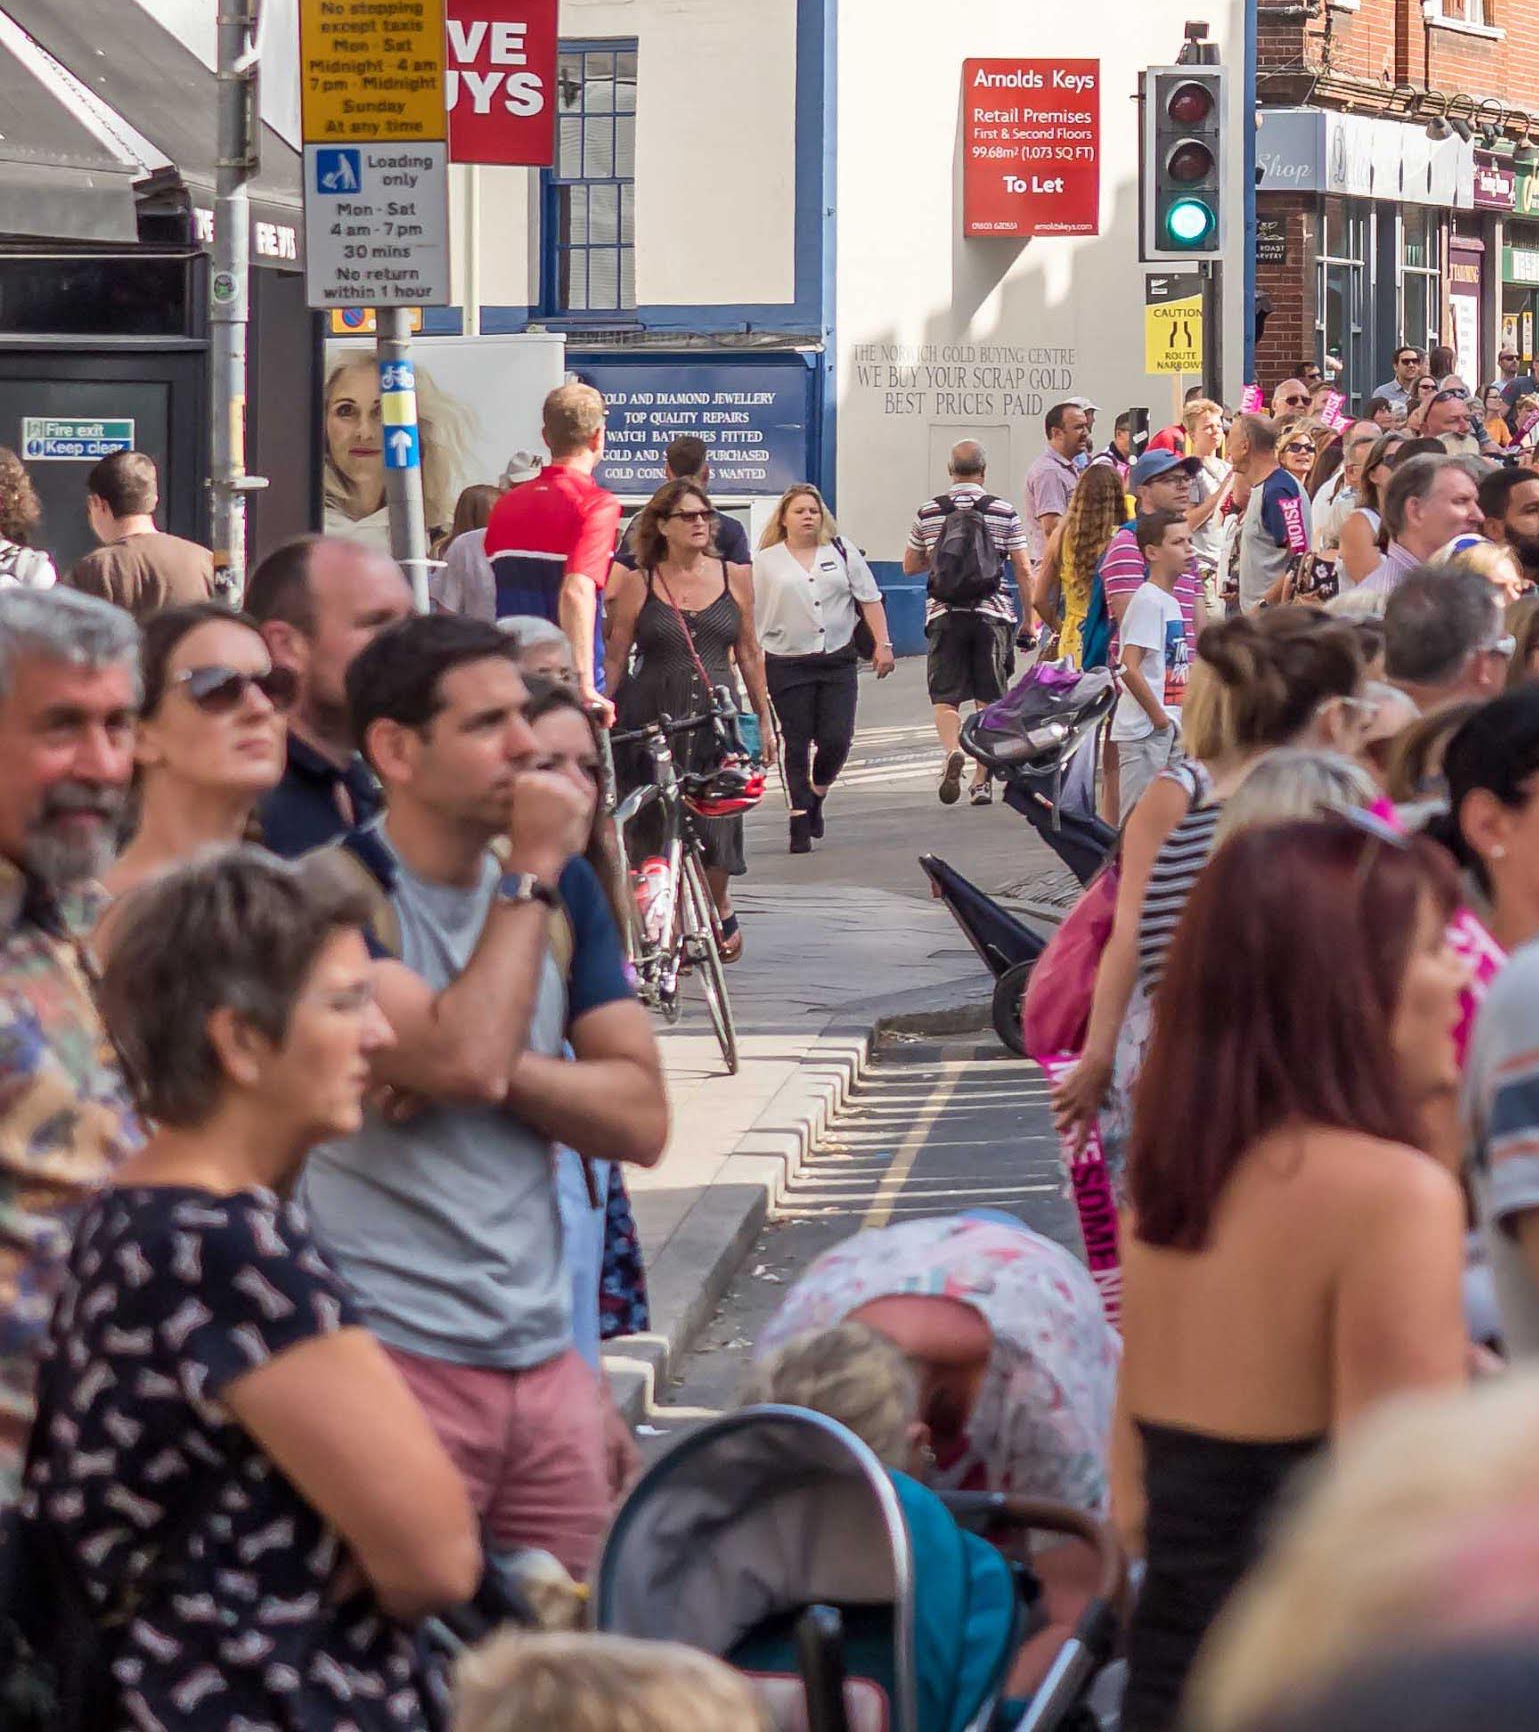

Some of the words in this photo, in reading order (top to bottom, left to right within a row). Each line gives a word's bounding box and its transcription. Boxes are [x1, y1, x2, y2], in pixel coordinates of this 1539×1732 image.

[320, 2, 344, 14] No
[350, 1, 423, 17] stopping
[320, 20, 375, 34] except
[383, 19, 423, 32] taxis
[334, 39, 368, 51] Mon
[383, 38, 412, 51] Sat
[447, 20, 527, 65] VE
[310, 59, 383, 76] Midnight
[397, 59, 409, 71] 4
[414, 62, 436, 71] am
[309, 79, 320, 90] 7
[323, 80, 348, 92] pm
[362, 76, 436, 92] Midnight
[974, 69, 1043, 88] Arnolds
[1053, 70, 1094, 93] Keys
[342, 99, 406, 115] Sunday
[974, 108, 1018, 123] Retail
[1024, 109, 1092, 123] Premises
[326, 121, 344, 133] At
[351, 122, 380, 135] any
[386, 119, 423, 132] time
[974, 129, 998, 139] First
[1001, 129, 1010, 139] &
[1013, 128, 1054, 139] Second
[1058, 128, 1092, 139] Floors
[1056, 147, 1073, 160] SQ
[1076, 146, 1094, 162] FT)
[368, 155, 433, 170] Loading
[1256, 154, 1312, 184] Shop
[383, 173, 418, 188] only
[1002, 176, 1027, 193] To
[1032, 176, 1064, 193] Let
[337, 203, 373, 216] Mon
[388, 202, 415, 216] Sat
[331, 224, 342, 235] 4
[346, 226, 371, 235] am
[384, 223, 393, 235] 7
[398, 225, 422, 237] pm
[344, 245, 367, 258] 30
[372, 245, 411, 258] mins
[336, 268, 360, 281] No
[366, 268, 419, 280] return
[324, 286, 375, 298] within
[382, 286, 388, 297] 1
[393, 286, 432, 298] hour
[1153, 308, 1202, 317] CAUTION
[854, 344, 876, 361] THE
[943, 346, 975, 363] GOLD
[980, 347, 1024, 364] BUYING
[1028, 348, 1075, 365] CENTRE
[1165, 352, 1197, 360] ROUTE
[1157, 361, 1202, 369] NARROW
[858, 366, 882, 388] WE
[889, 367, 919, 388] BUY
[926, 366, 967, 389] YOUR
[973, 367, 1025, 389] SCRAP
[1029, 368, 1072, 390] GOLD
[631, 393, 653, 404] AND
[657, 393, 710, 405] DIAMOND
[713, 393, 776, 405] JEWELLERY
[885, 392, 926, 414] BEST
[936, 393, 993, 415] PRICES
[1003, 394, 1042, 415] PAID
[624, 412, 646, 423] TOP
[650, 412, 698, 425] QUALITY
[703, 412, 749, 423] REPAIRS
[46, 422, 72, 437] Fire
[76, 422, 104, 438] exit
[606, 431, 646, 442] WATCH
[721, 431, 763, 442] FITTED
[46, 440, 83, 456] Keep
[89, 439, 124, 454] clear
[602, 450, 632, 462] GOLD
[634, 450, 659, 462] AND
[706, 450, 769, 462] PURCHASED
[605, 468, 633, 479] GOLD
[719, 468, 765, 479] WANTED
[1283, 499, 1304, 548] NOISE
